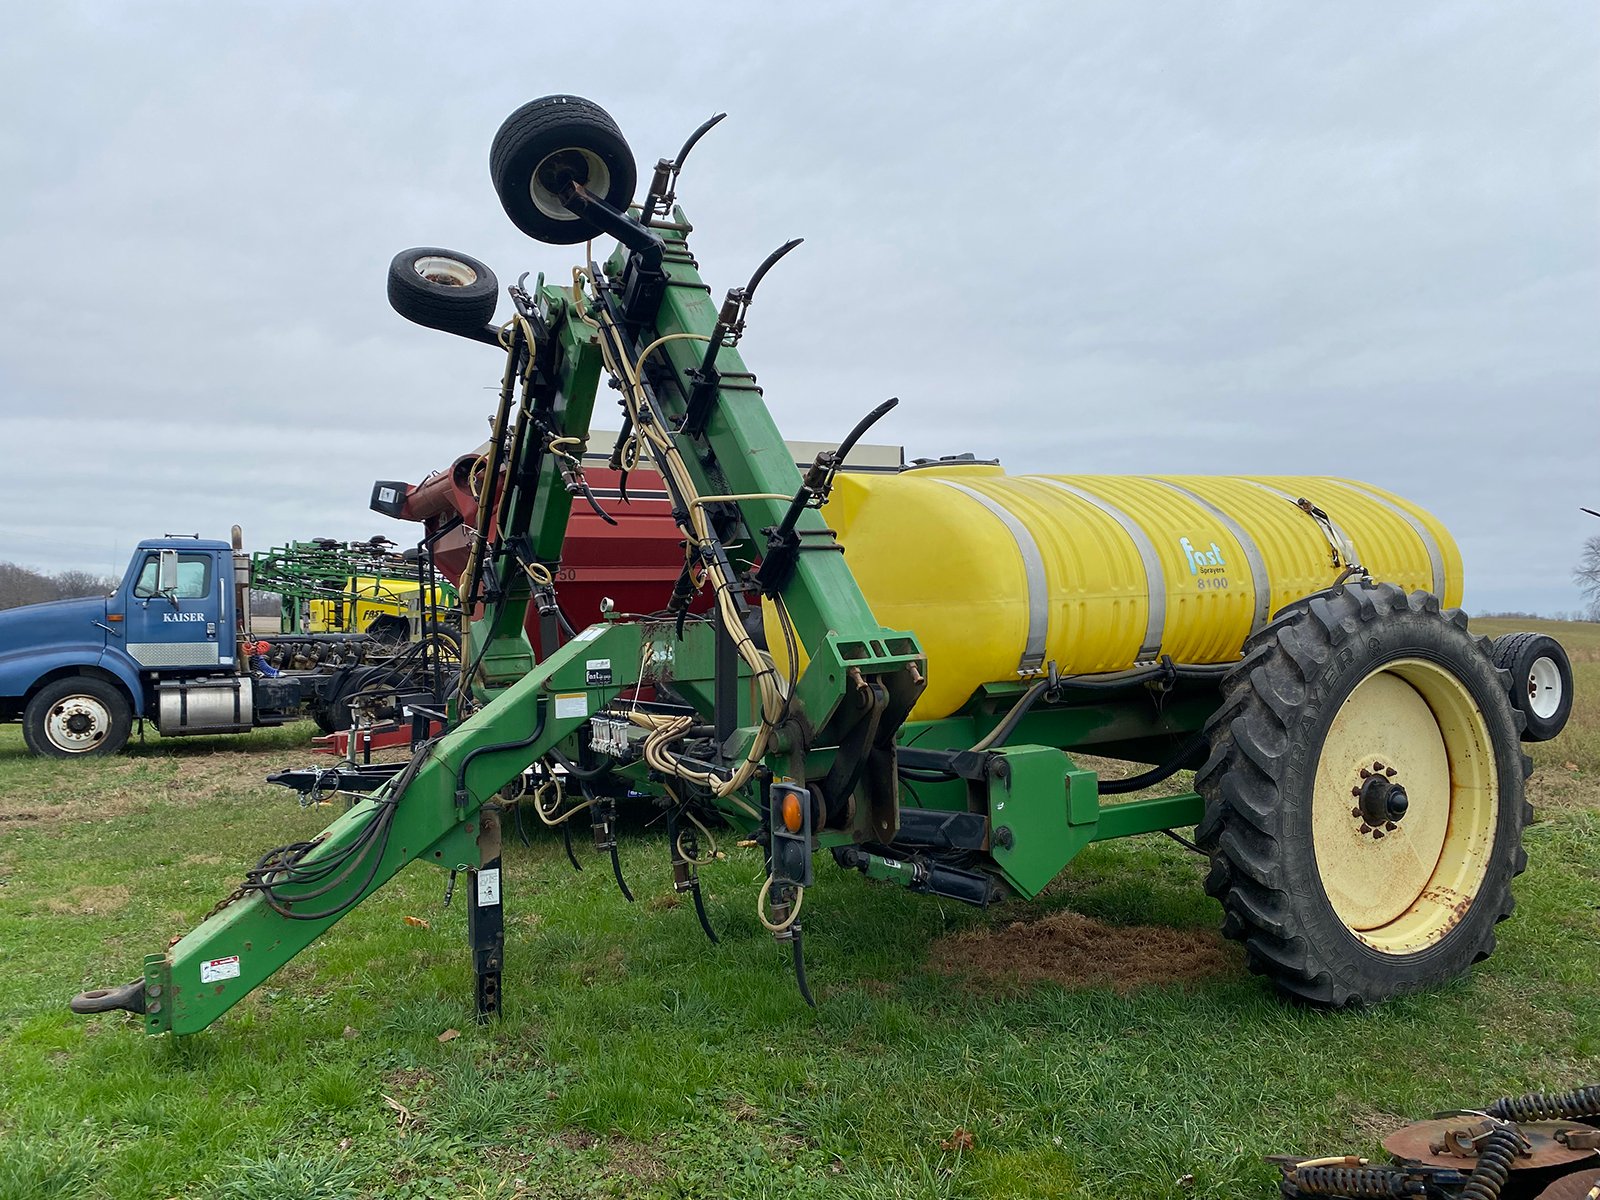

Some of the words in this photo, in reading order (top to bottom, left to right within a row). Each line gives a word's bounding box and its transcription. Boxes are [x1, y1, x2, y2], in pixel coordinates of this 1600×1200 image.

[1179, 537, 1226, 576] fast
[1199, 567, 1225, 575] Sprayers
[1197, 578, 1228, 590] 8100
[163, 612, 205, 622] KAISER
[1282, 647, 1356, 838] SPRAYER
